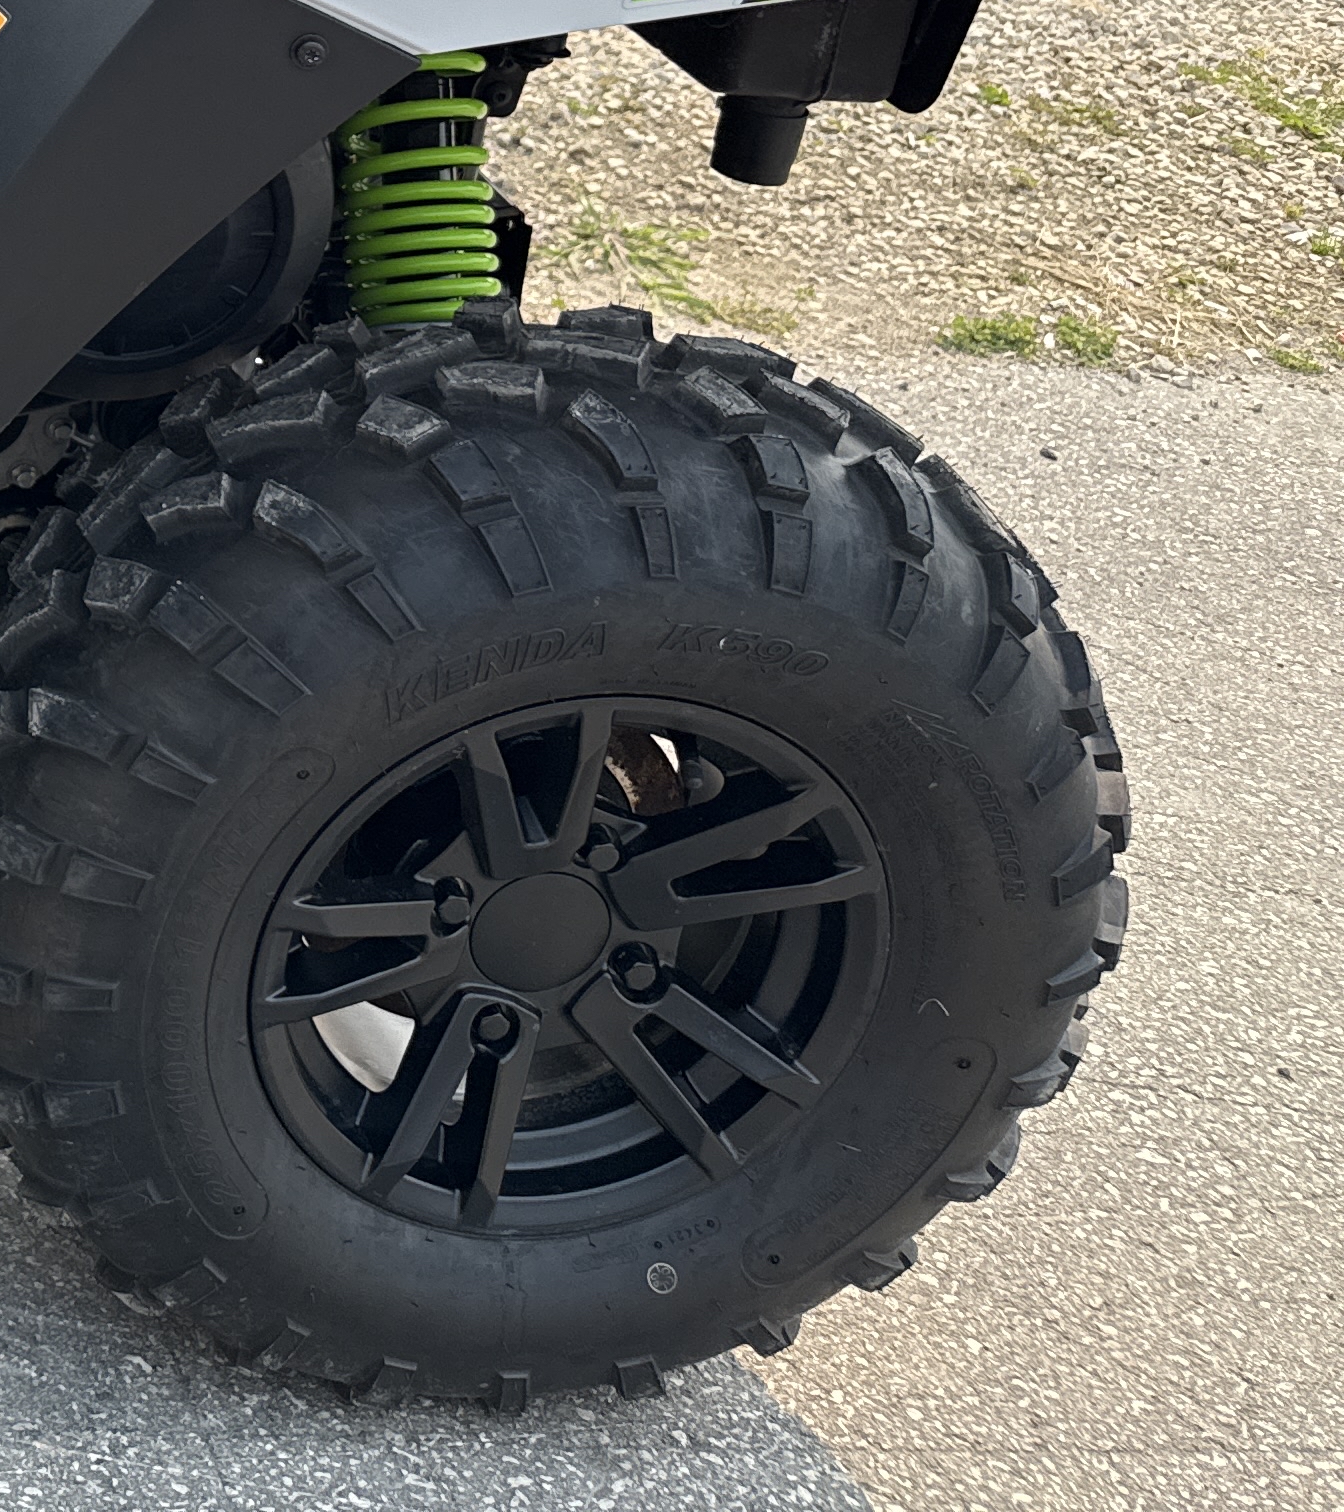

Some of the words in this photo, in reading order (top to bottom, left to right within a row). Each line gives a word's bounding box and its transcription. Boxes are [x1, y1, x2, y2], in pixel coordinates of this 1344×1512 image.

[386, 620, 610, 726] KENDA
[656, 622, 831, 677] K590
[960, 748, 1028, 906] ROTATION
